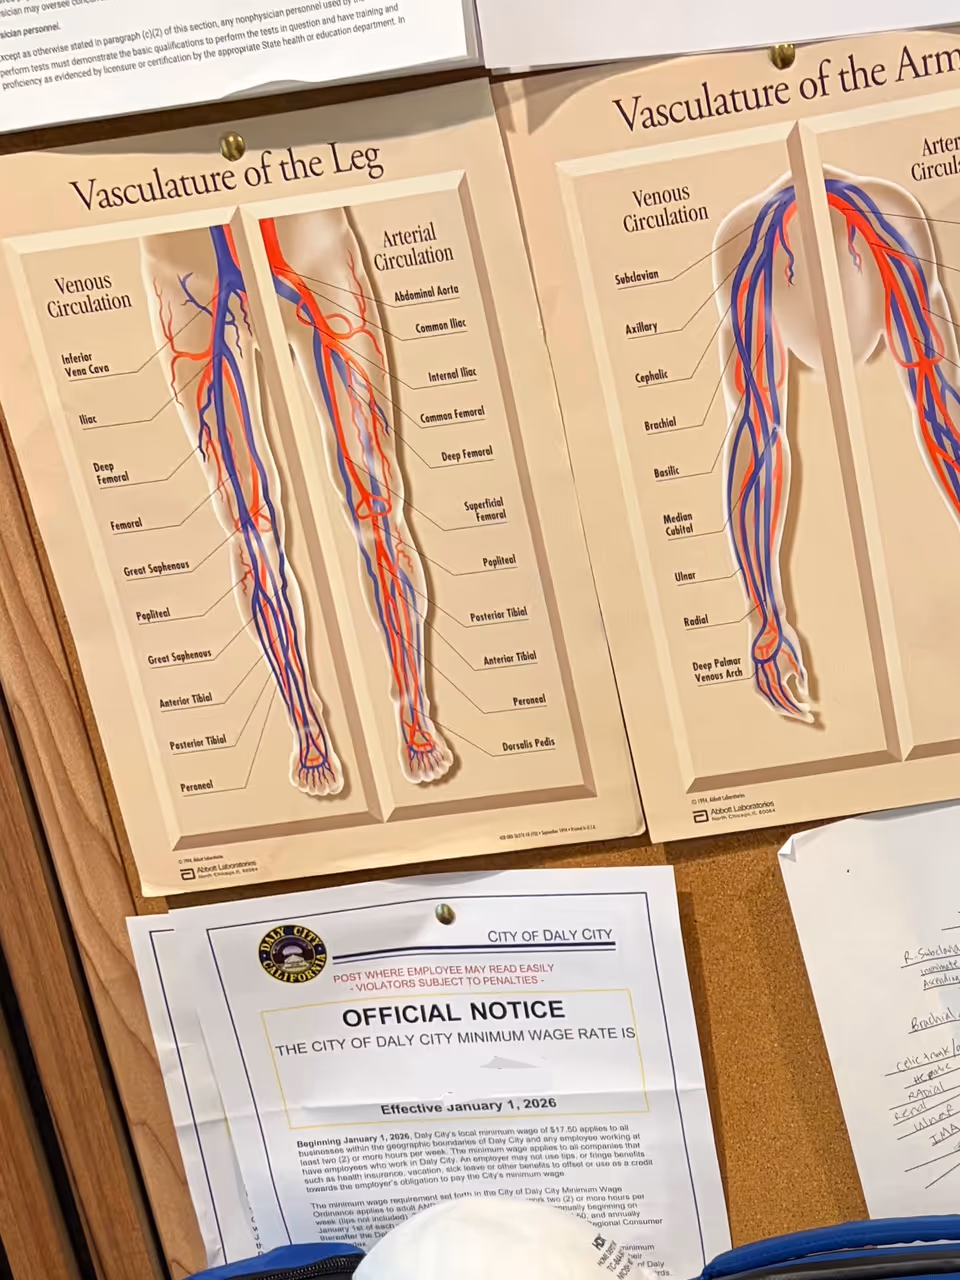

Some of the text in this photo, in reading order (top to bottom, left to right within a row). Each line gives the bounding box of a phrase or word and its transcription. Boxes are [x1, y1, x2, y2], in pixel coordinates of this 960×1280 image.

[612, 82, 791, 131] Vasculature
[799, 58, 830, 100] of
[838, 54, 887, 92] the
[70, 141, 384, 210] Vasculature of the Leg
[632, 186, 690, 208] Venous
[623, 205, 709, 232] Circulation
[384, 221, 437, 248] Arterial
[374, 246, 454, 271] Circulation
[54, 275, 112, 294] Venous
[615, 270, 659, 285] Subclavian
[395, 285, 459, 302] Abdominal Aorta
[47, 293, 132, 318] Circulation
[635, 369, 668, 384] Cephalic
[420, 405, 485, 423] Common Femoral
[123, 561, 190, 577] Great Saphenous
[482, 554, 516, 568] Popliteal
[674, 571, 696, 582] Ulnar
[470, 606, 528, 622] Posterior Tibial
[683, 614, 709, 627] Radial
[692, 657, 741, 671] Deep Palmar
[694, 667, 743, 682] Venous Arch
[513, 693, 546, 706] Peroneal
[502, 736, 555, 751] Dorsalis Pedis
[260, 926, 322, 951] DALY CITY
[488, 928, 612, 943] CITY OF DALY CITY
[263, 954, 326, 983] CALIFORNIA
[333, 964, 554, 983] POST WHERE EMPLOYEE MAY READ EASILY
[355, 976, 538, 992] VIOLATORS SUBJECT TO PENALTIES
[342, 1000, 565, 1027] OFFICIAL NOTICE
[275, 1027, 635, 1056] THE CITY OF DALY CITY MINIMUM WAGE RATE IS
[380, 1103, 442, 1115] Effective
[507, 1100, 520, 1110] 1,
[523, 1098, 557, 1108] 2026
